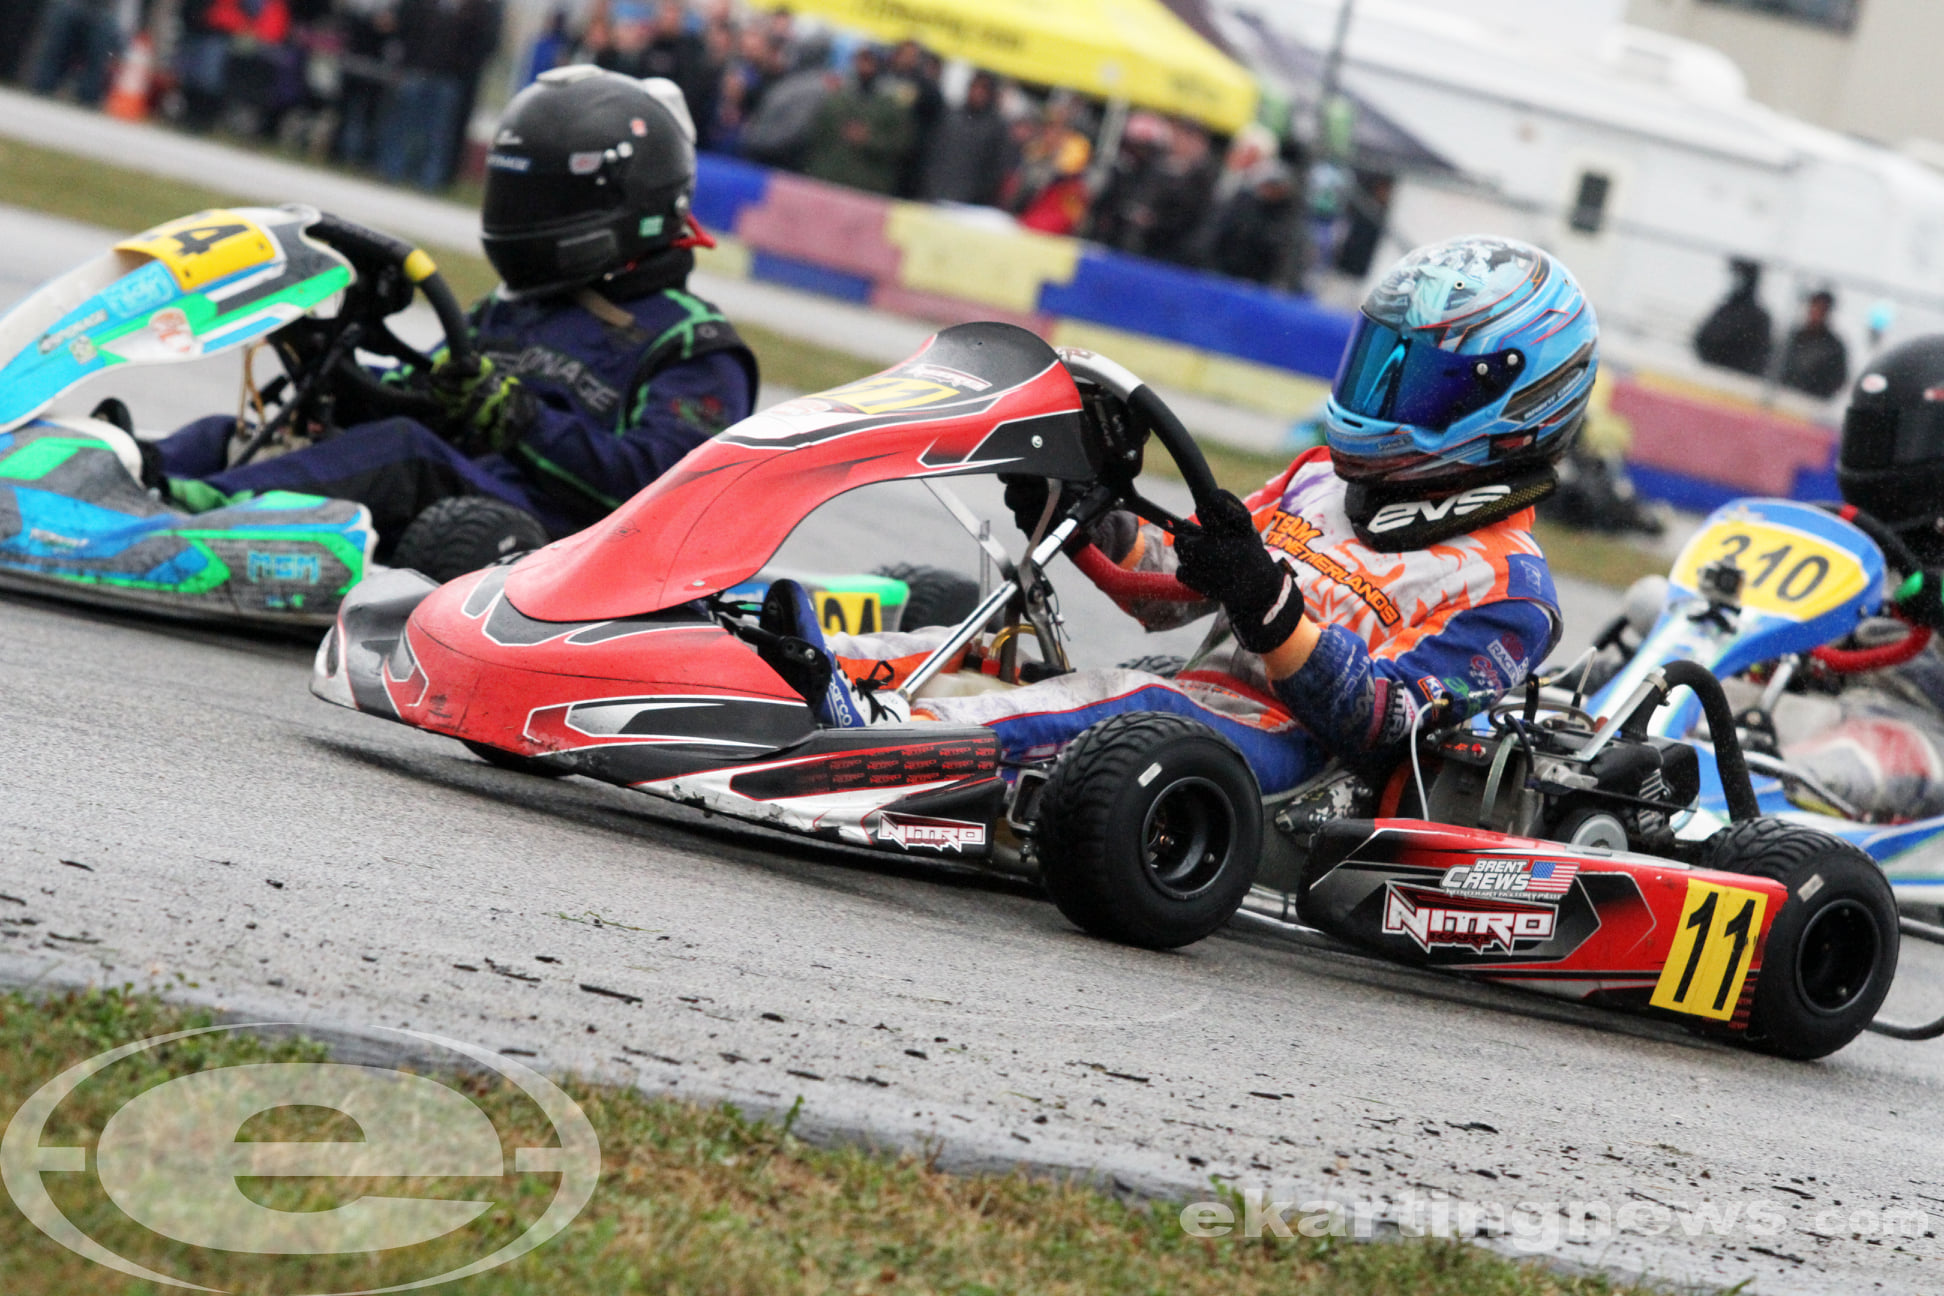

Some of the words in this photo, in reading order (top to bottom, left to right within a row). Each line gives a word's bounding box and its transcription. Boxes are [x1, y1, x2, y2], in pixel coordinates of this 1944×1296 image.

[1274, 511, 1322, 541] TEAM
[1284, 538, 1399, 626] NETHERLANDS
[879, 815, 986, 852] NITRO
[1441, 865, 1532, 891] CREWS
[1474, 860, 1528, 873] BRENT
[1385, 891, 1555, 951] NITRO
[1672, 891, 1756, 1011] 11
